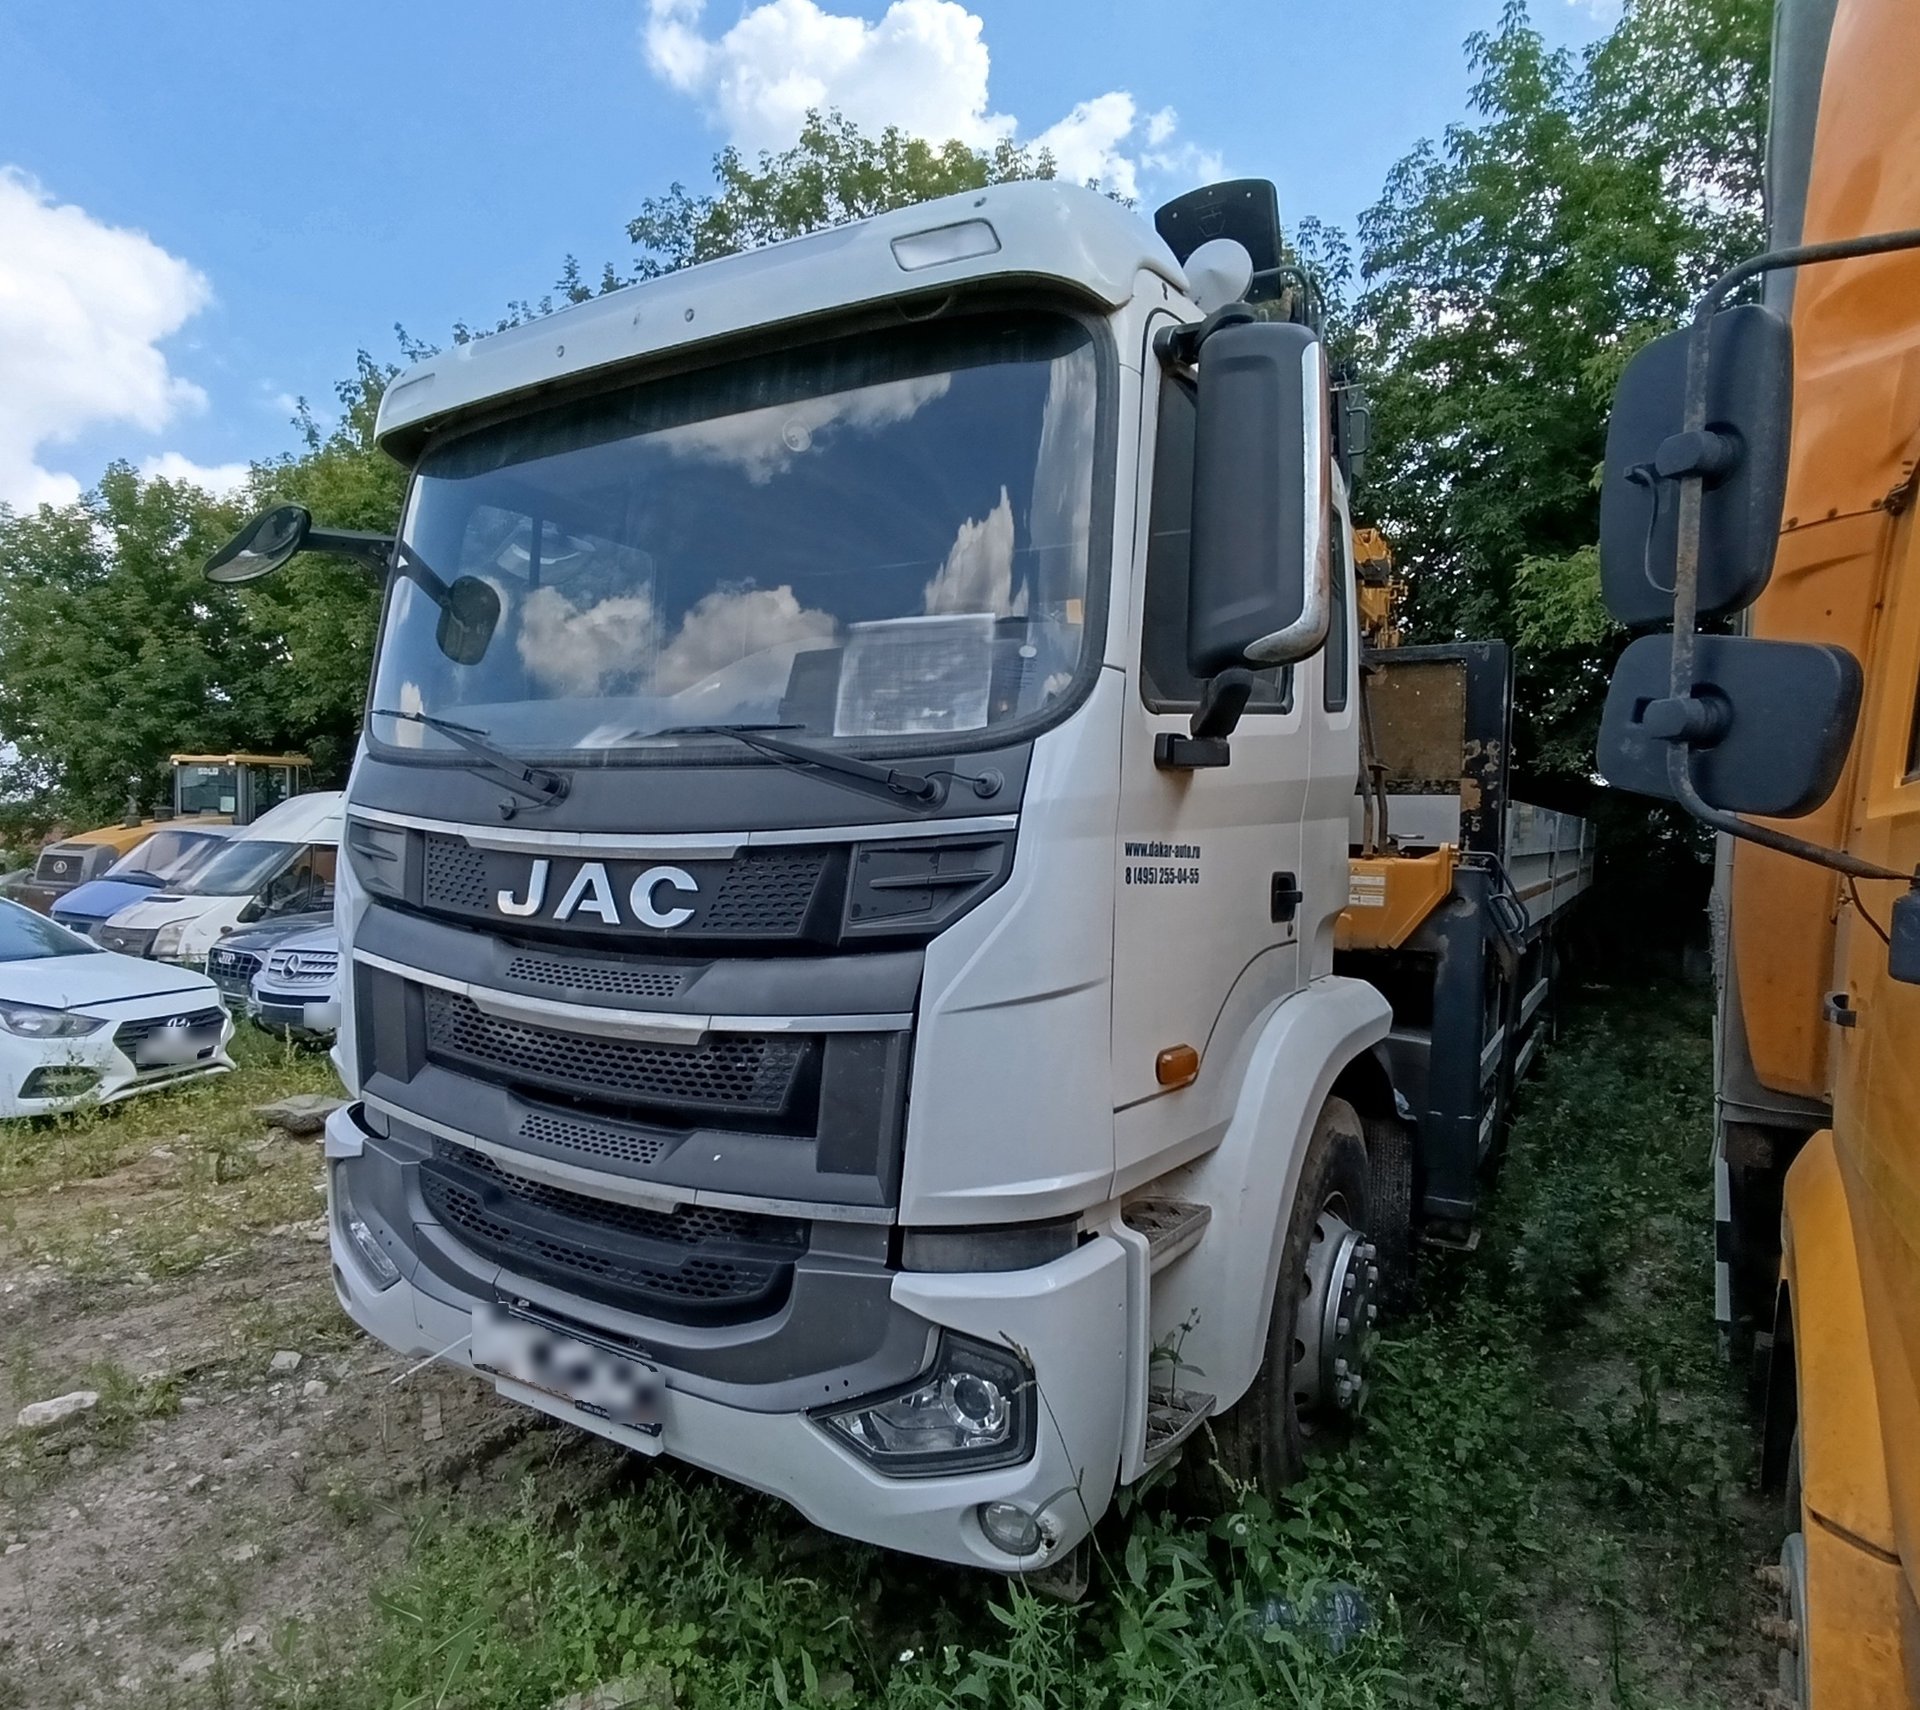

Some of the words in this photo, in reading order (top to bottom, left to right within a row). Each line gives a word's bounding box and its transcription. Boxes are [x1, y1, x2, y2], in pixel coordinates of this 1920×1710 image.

[1125, 841, 1200, 859] www.dakar-auto.ru
[1125, 867, 1132, 885] 8
[1133, 867, 1158, 884] (495)
[1159, 867, 1199, 884] 255-04-55
[498, 859, 698, 929] JAC
